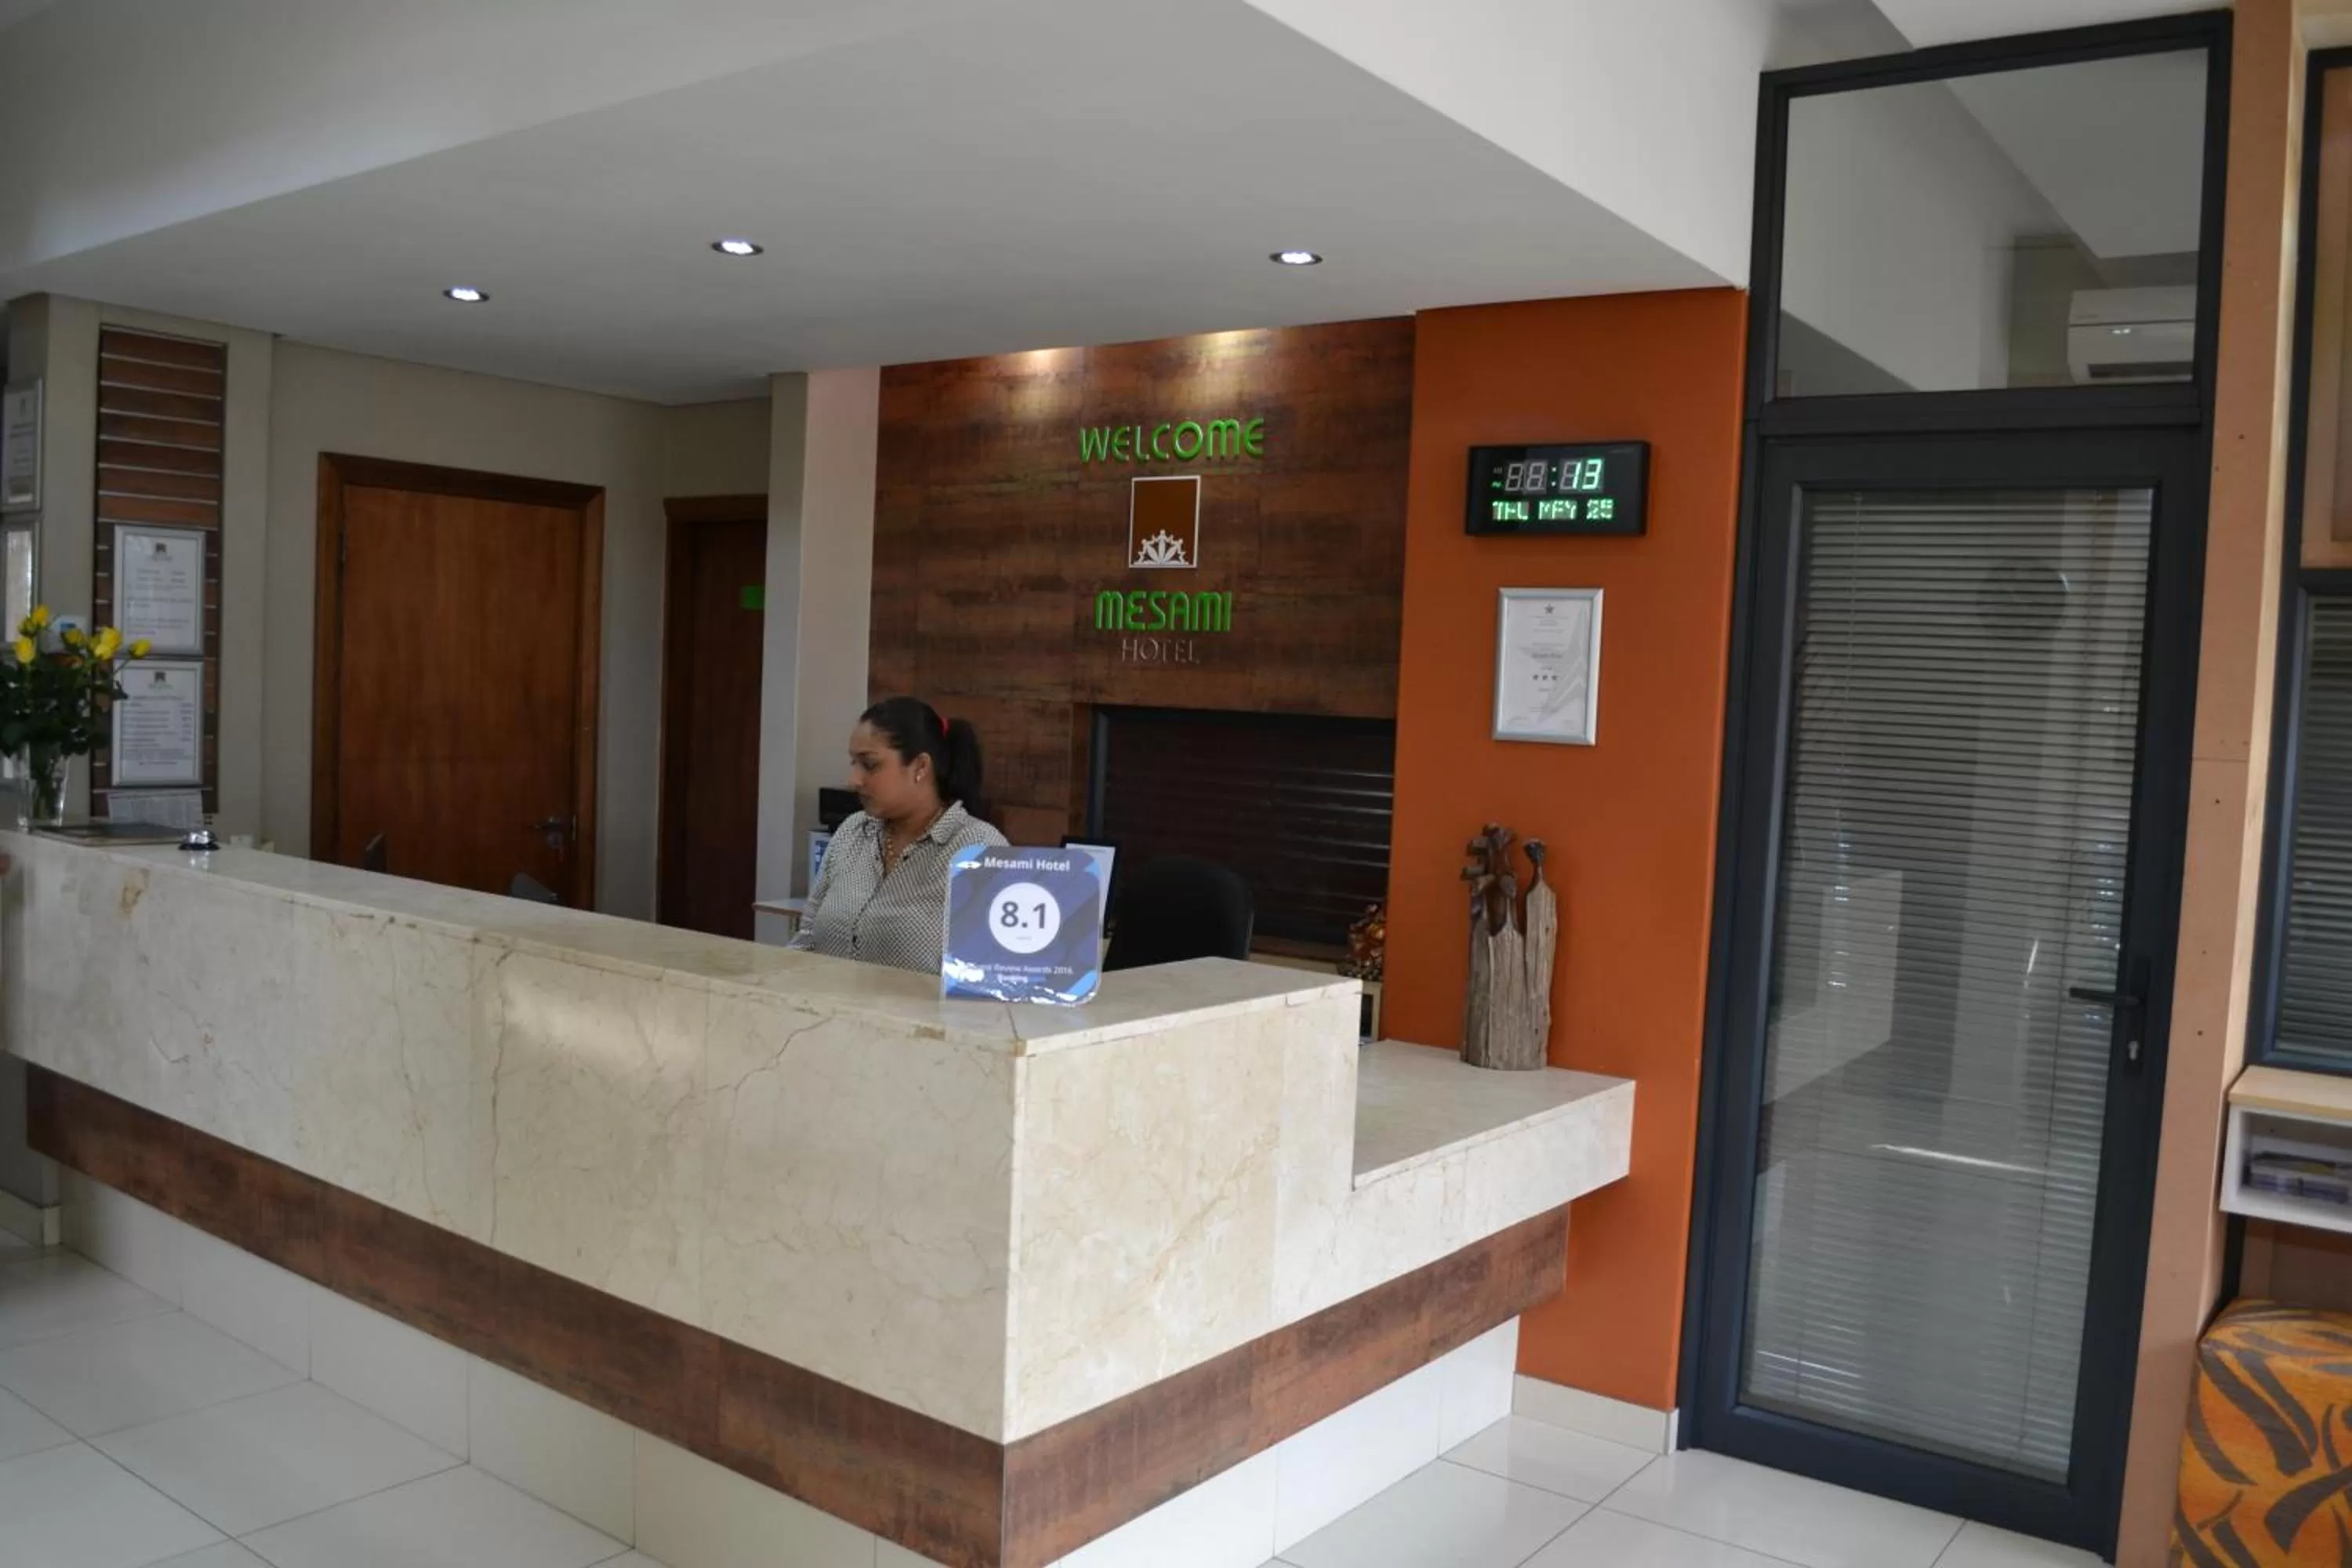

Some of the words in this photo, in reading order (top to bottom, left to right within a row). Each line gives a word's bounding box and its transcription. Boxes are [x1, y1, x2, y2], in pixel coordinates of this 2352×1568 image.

[1079, 417, 1265, 463] WELCOME
[1096, 590, 1232, 631] MESAMI
[1122, 637, 1200, 663] HOTEL
[984, 857, 1033, 869] Mesami
[1036, 859, 1070, 872] Hotel
[1000, 901, 1046, 928] 8.1
